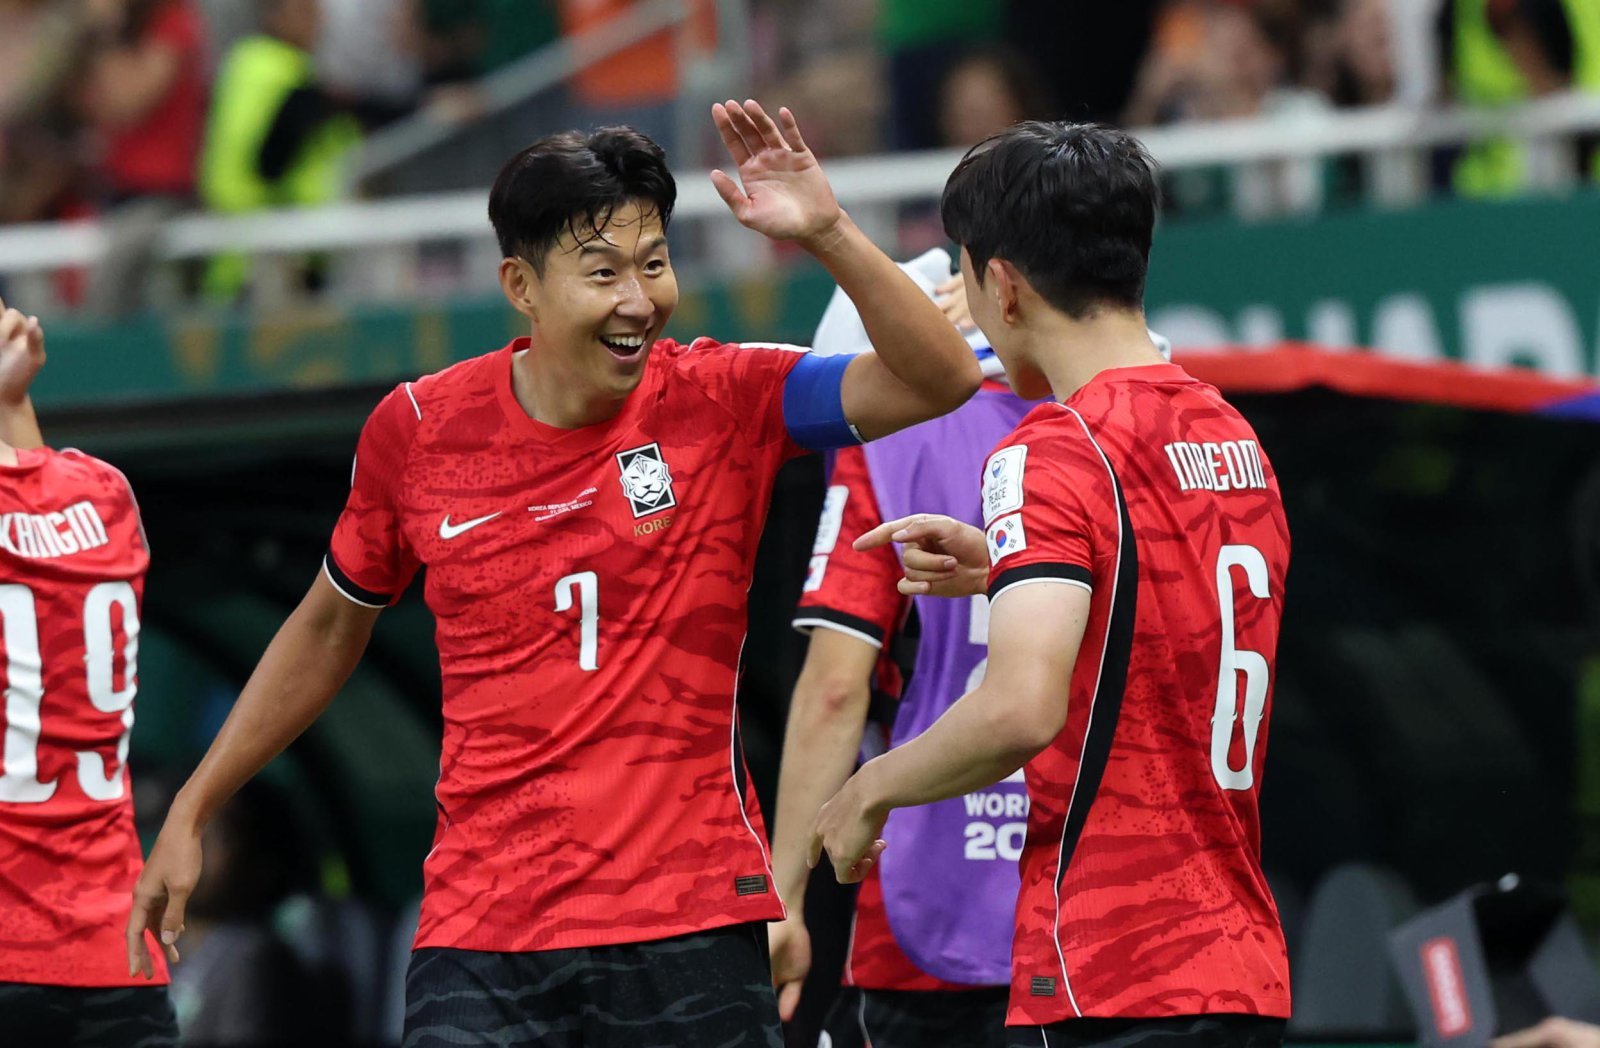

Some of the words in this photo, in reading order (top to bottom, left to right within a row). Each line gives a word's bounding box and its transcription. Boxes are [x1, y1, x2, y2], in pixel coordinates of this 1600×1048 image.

[1163, 439, 1267, 492] INBEOM
[0, 500, 109, 559] KANGIN
[553, 570, 599, 671] 7
[1210, 543, 1271, 791] 6
[0, 581, 141, 803] 19
